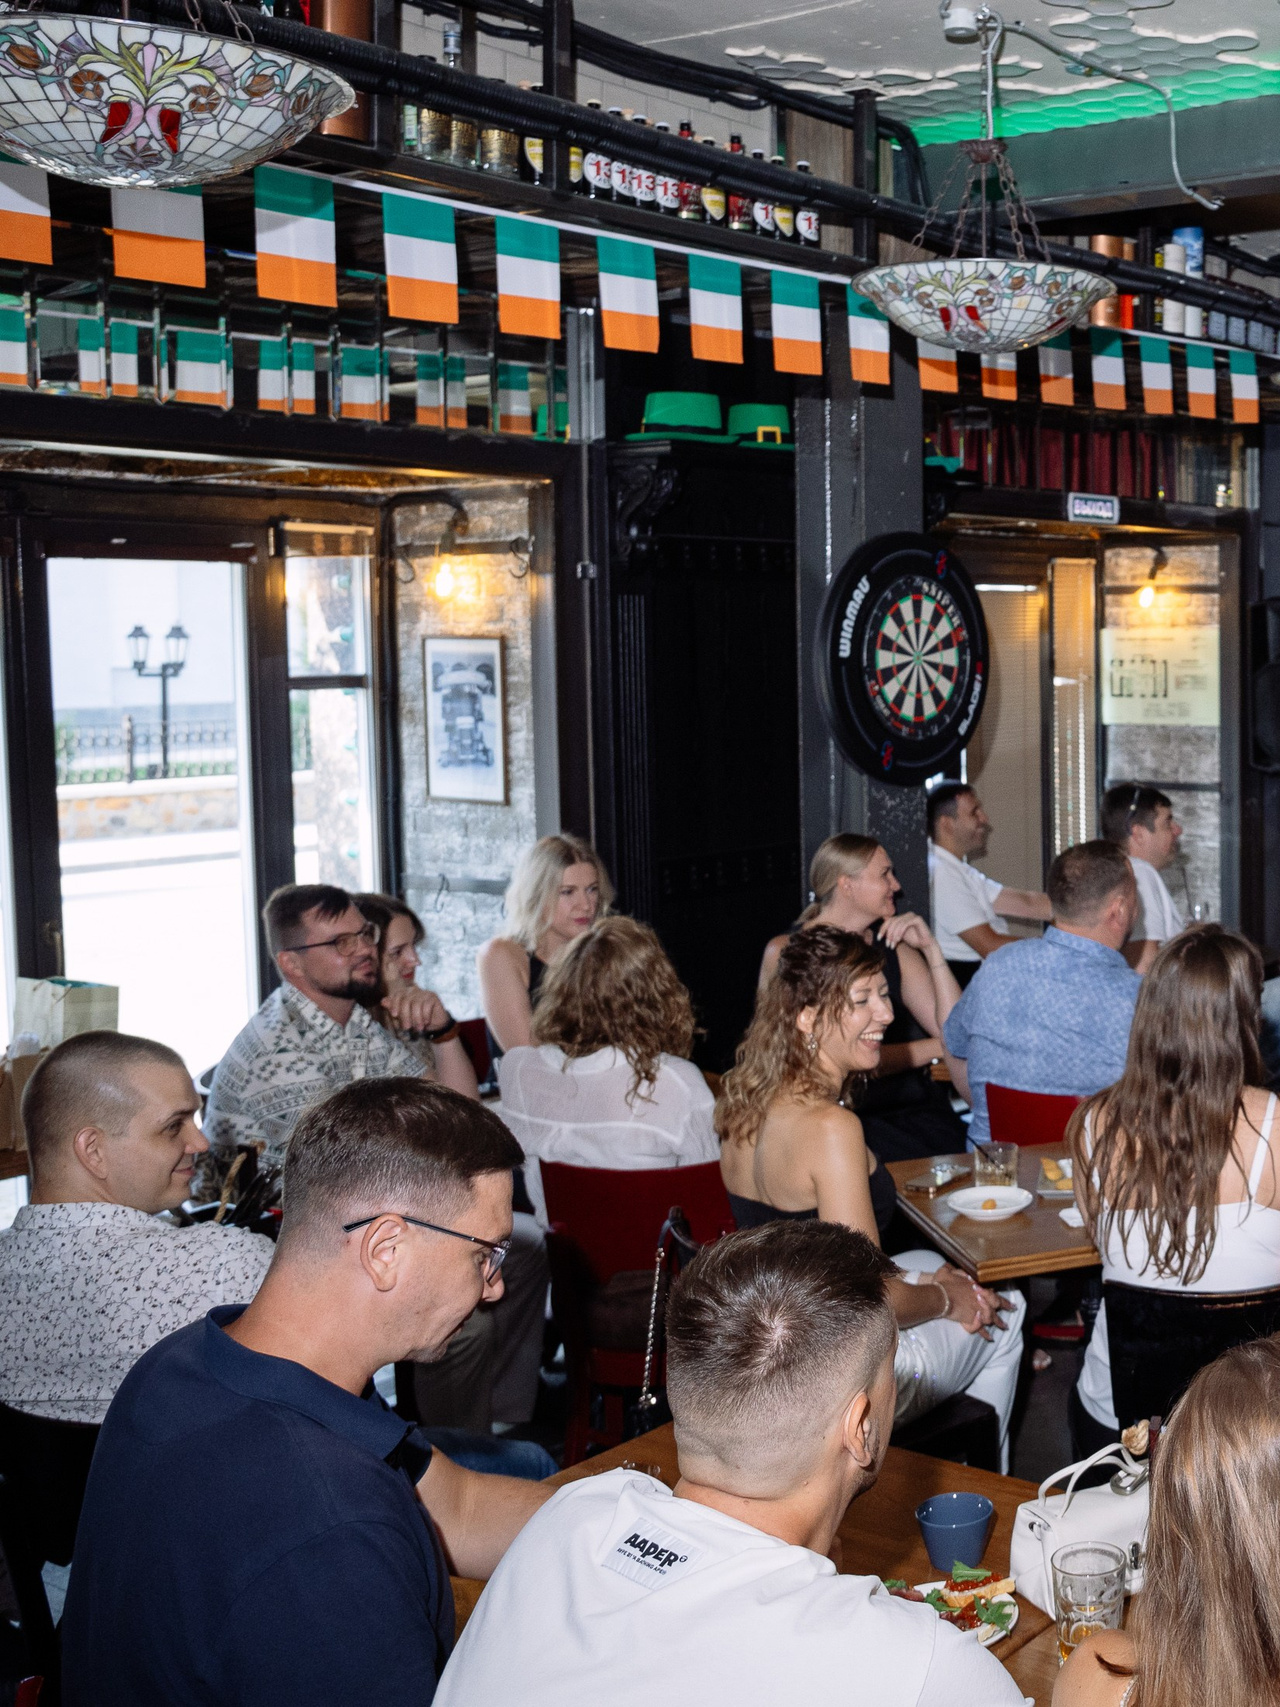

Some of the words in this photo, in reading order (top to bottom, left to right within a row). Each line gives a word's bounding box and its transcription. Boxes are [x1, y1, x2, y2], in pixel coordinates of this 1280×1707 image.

[632, 174, 656, 191] 13
[838, 574, 871, 659] WINMAU
[957, 680, 982, 736] BLADE
[623, 1532, 679, 1568] AAPER
